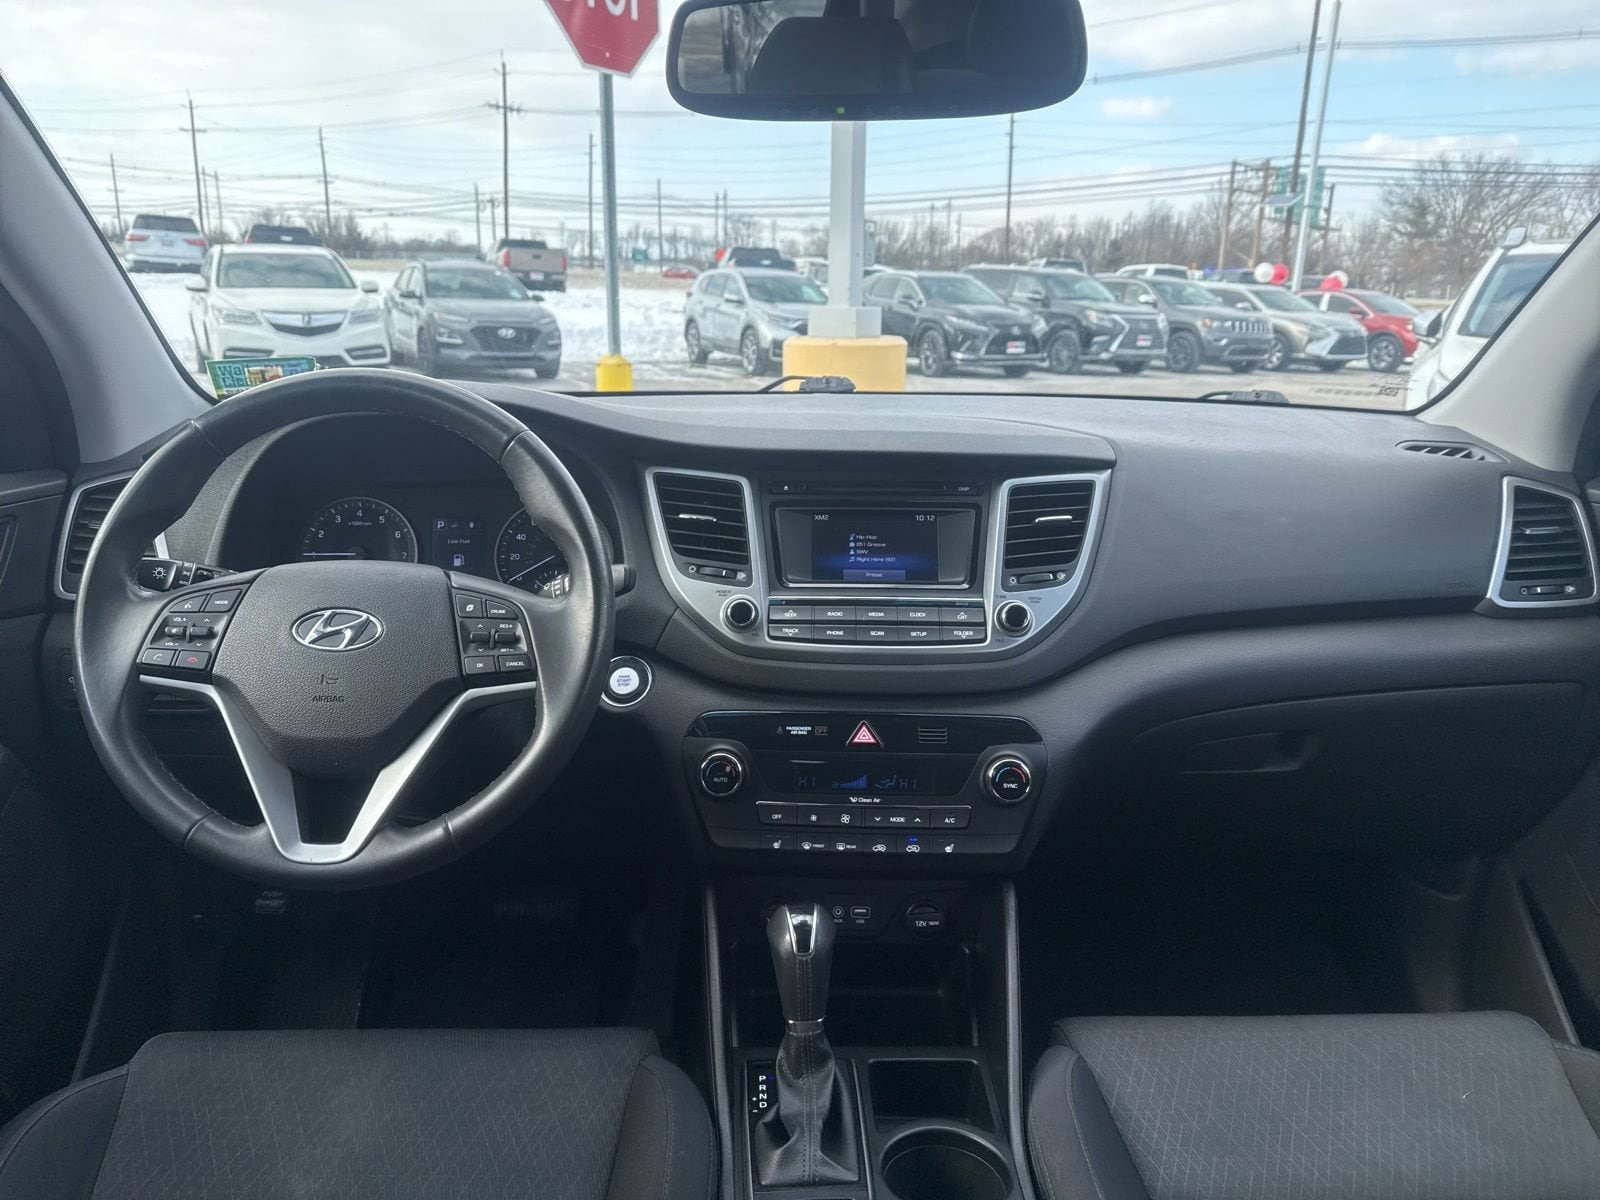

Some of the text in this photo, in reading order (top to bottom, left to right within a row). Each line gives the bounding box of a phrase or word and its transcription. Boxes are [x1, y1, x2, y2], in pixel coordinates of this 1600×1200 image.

[356, 509, 362, 517] 4
[335, 515, 341, 523] 3
[379, 515, 385, 523] 5
[437, 520, 445, 529] P
[318, 530, 324, 538] 2
[395, 530, 401, 538] 6
[516, 533, 527, 541] 40
